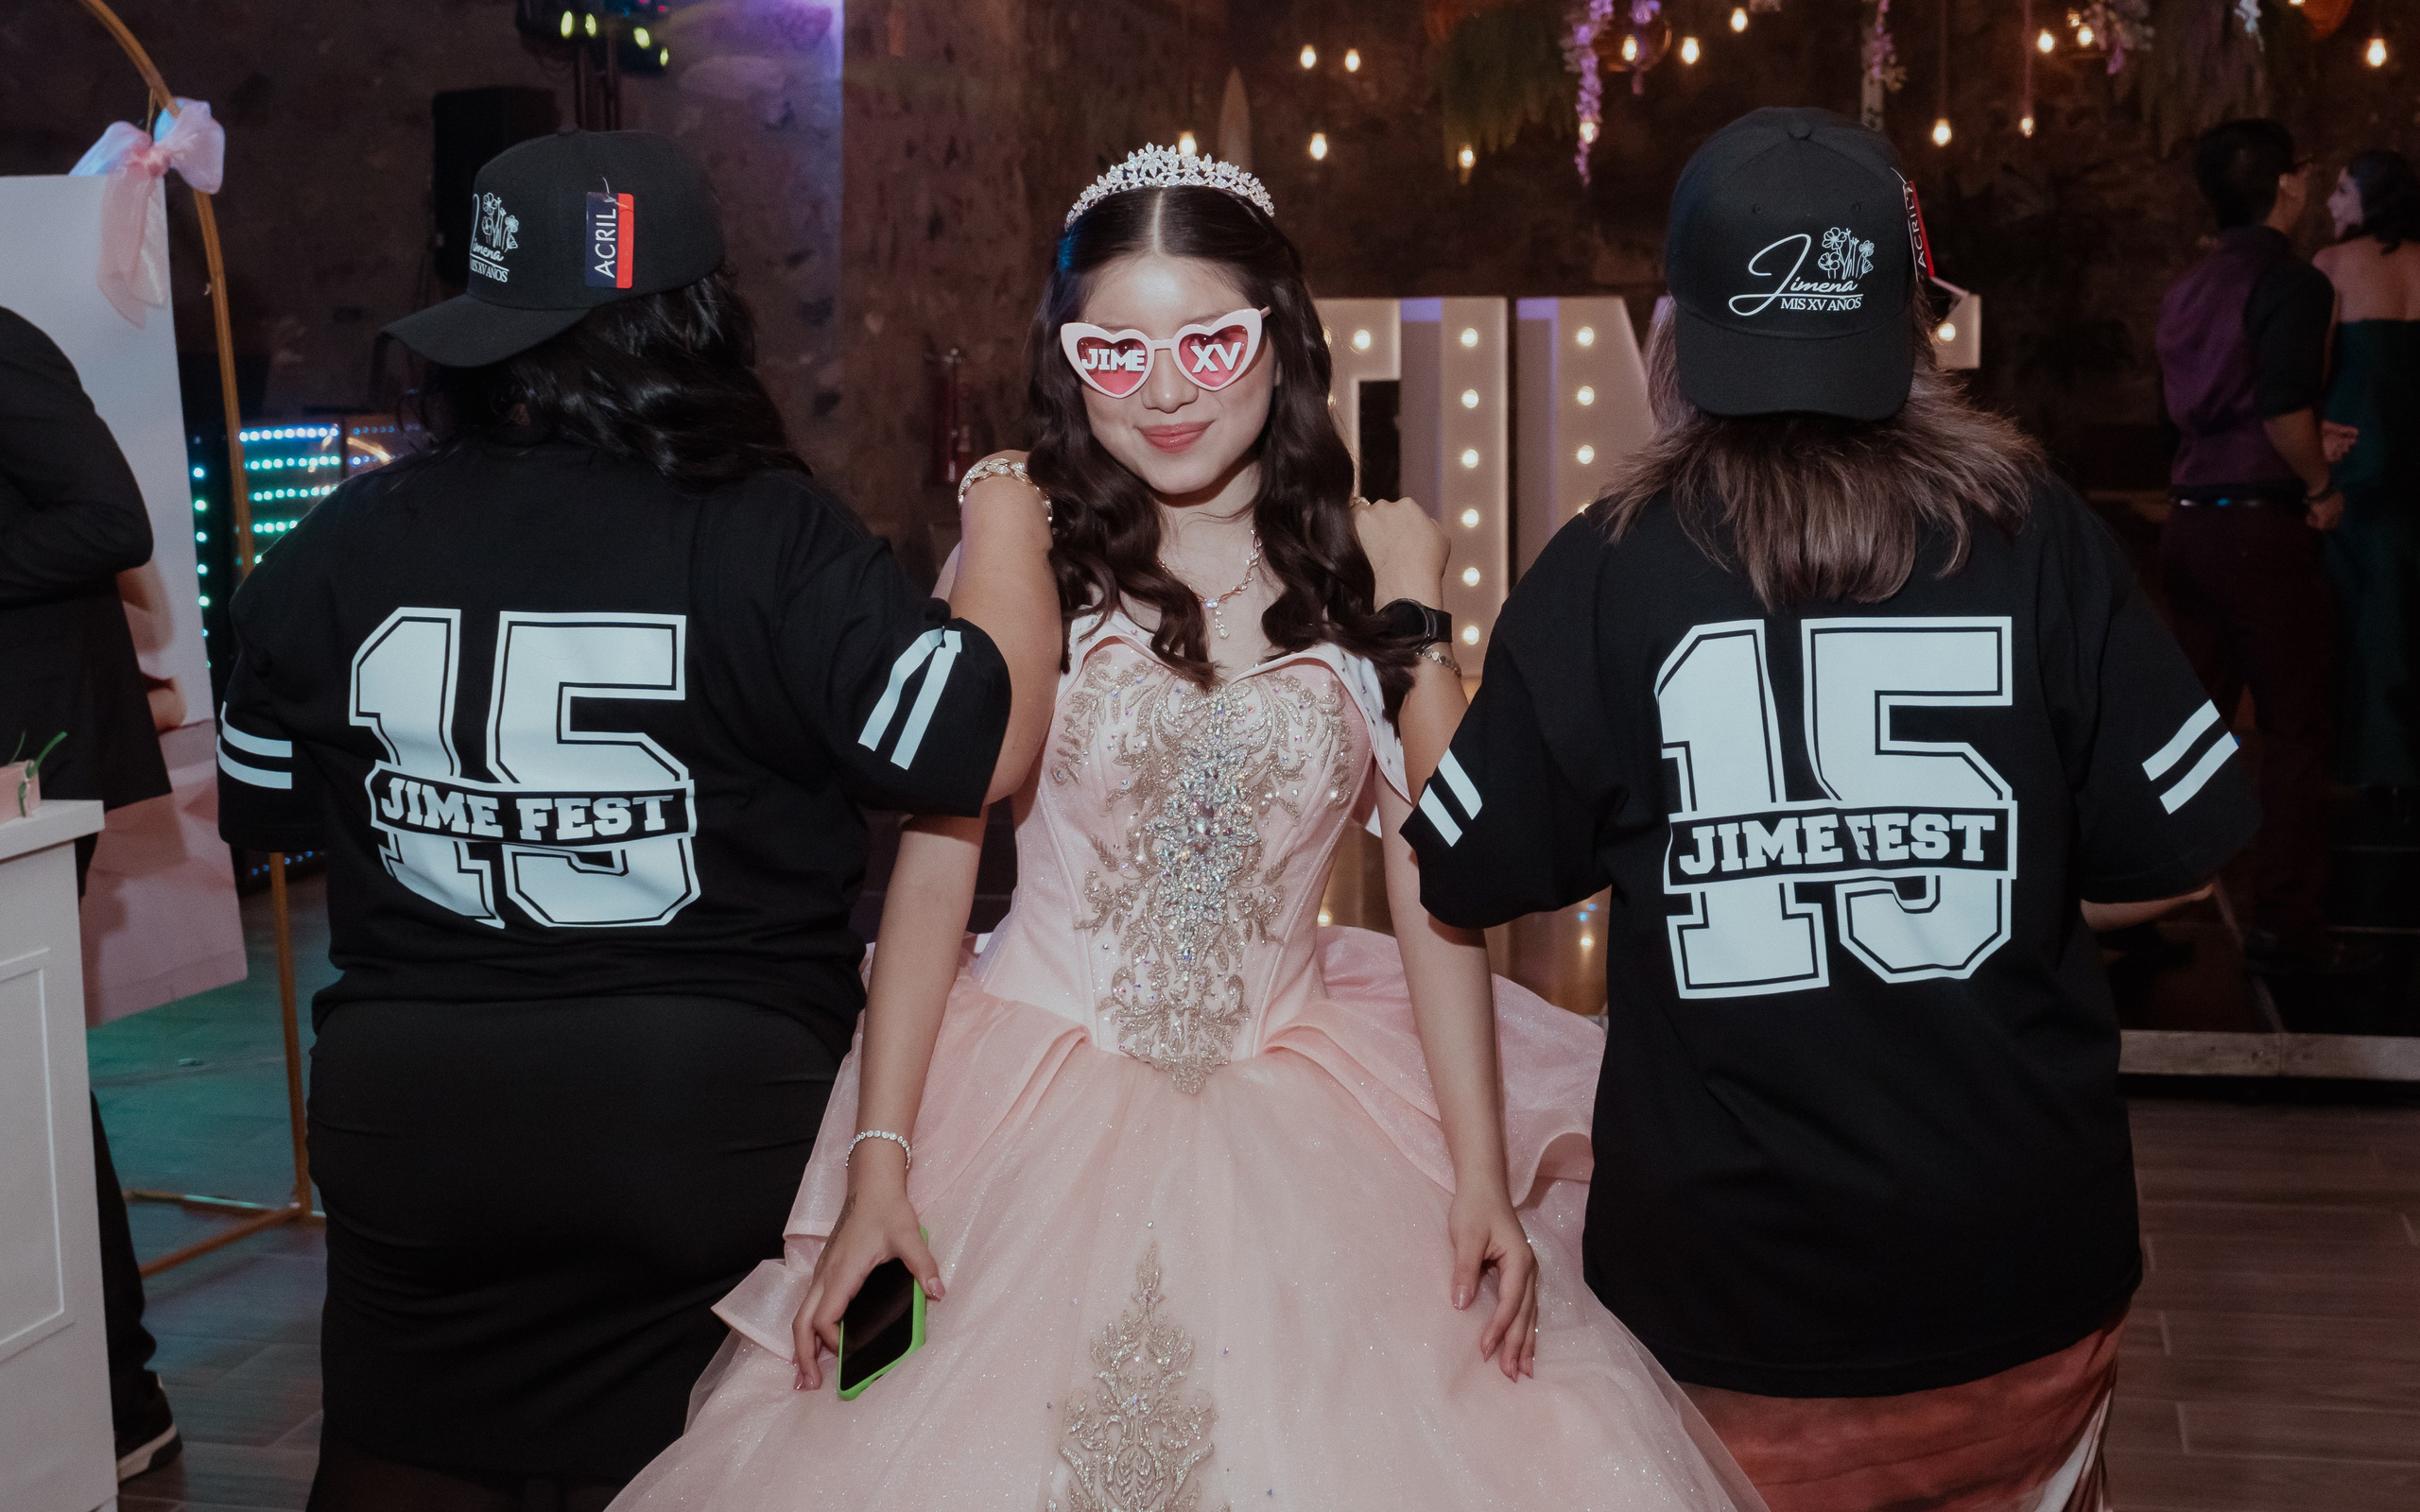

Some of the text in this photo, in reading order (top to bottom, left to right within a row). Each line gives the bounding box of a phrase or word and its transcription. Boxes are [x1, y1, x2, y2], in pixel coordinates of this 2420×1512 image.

[1729, 233, 1860, 316] Jimena
[1780, 295, 1862, 311] MIS XV AÑOS
[1081, 341, 1243, 373] JIME XV
[349, 607, 701, 929] 15
[381, 776, 674, 841] JIME FEST
[1653, 616, 2013, 999] 15
[1679, 812, 1996, 875] JIME FEST
